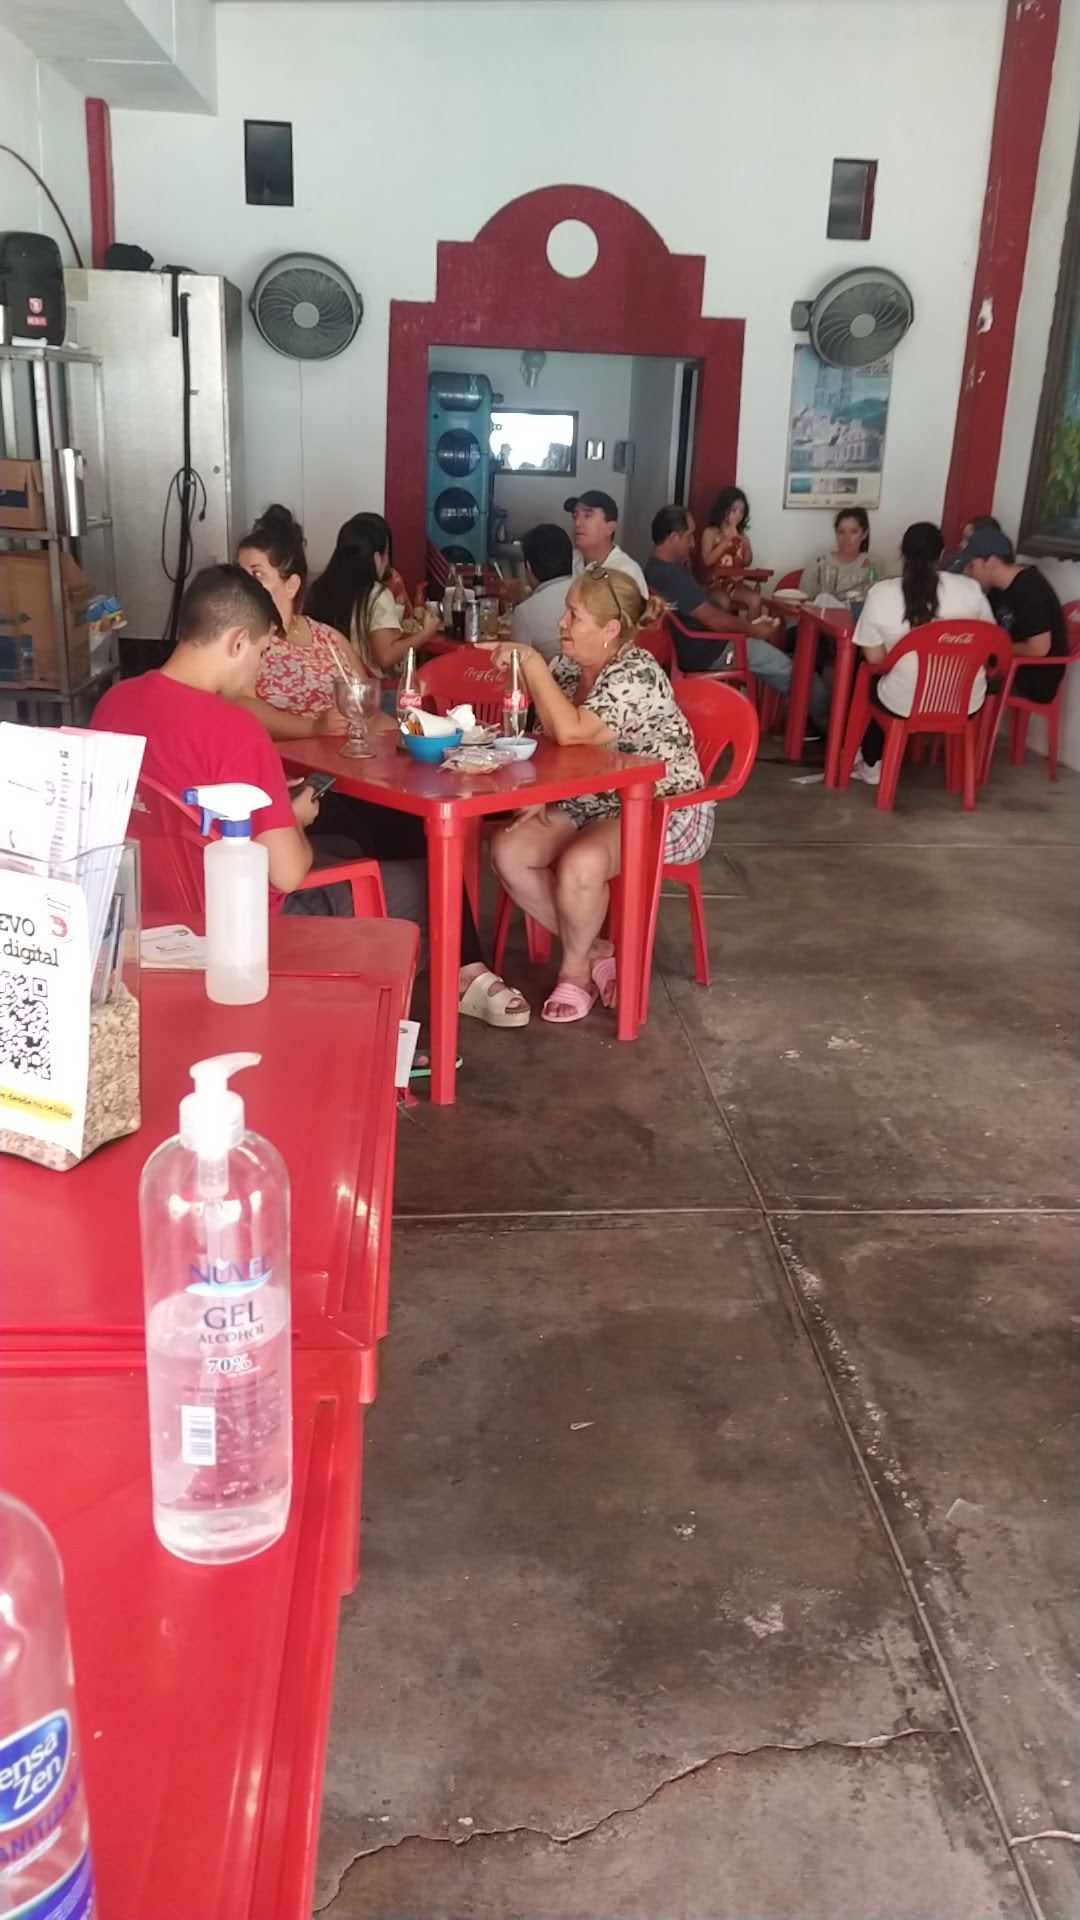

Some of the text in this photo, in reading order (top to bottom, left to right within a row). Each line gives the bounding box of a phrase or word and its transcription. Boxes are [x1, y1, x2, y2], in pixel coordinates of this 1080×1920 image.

[2, 938, 59, 967] digital
[203, 1301, 262, 1330] GEL
[197, 1323, 266, 1345] ALCOHOL
[207, 1356, 252, 1374] 70%
[13, 1755, 63, 1811] Zen
